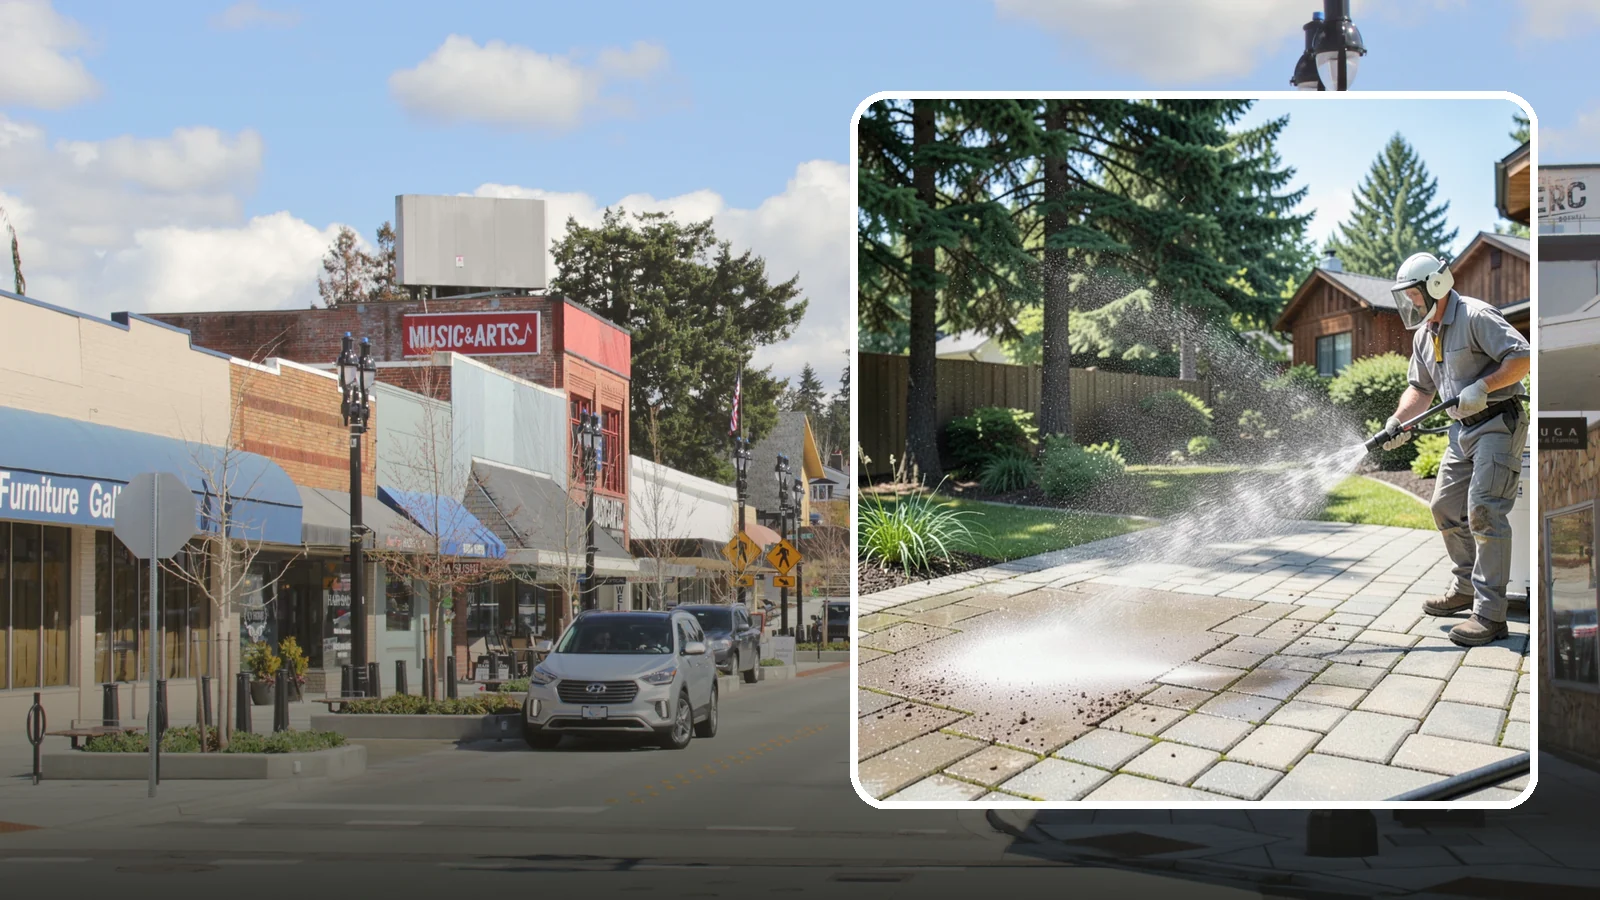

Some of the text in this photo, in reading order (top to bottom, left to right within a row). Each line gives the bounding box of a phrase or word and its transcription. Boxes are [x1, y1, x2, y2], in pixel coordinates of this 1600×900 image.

[0, 471, 79, 515] Furniture
[453, 563, 480, 575] SUSHI
[327, 594, 340, 606] HAIR
